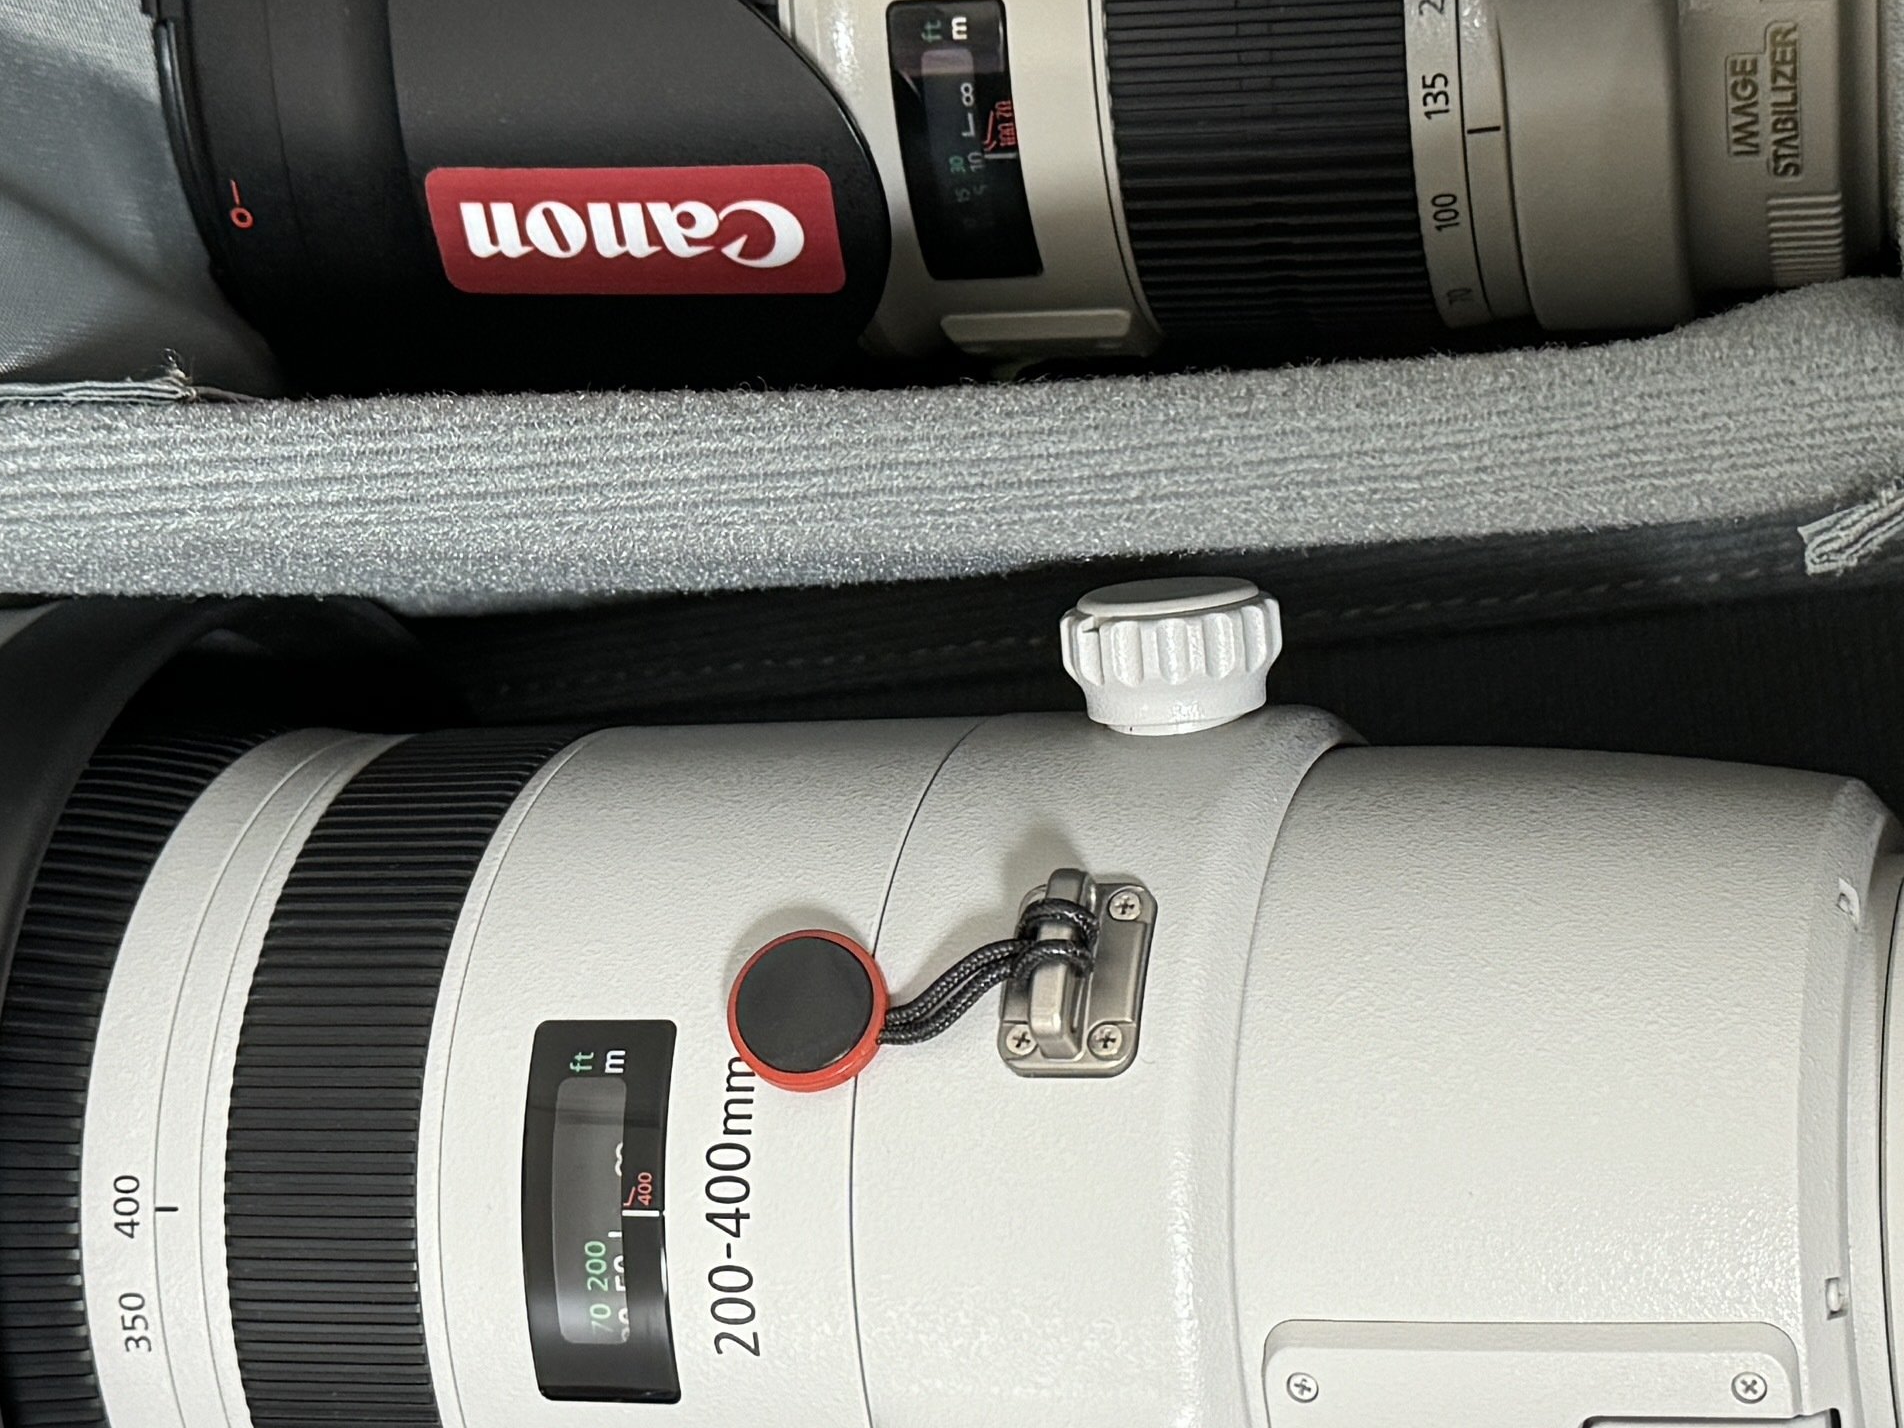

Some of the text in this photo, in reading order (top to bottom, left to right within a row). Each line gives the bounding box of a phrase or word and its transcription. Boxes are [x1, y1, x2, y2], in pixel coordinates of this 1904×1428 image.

[921, 19, 943, 43] ft
[950, 16, 968, 41] m
[1422, 72, 1450, 120] 135
[1730, 56, 1761, 156] IMAGE
[1769, 22, 1800, 177] STABILIZER
[459, 200, 805, 269] Canon
[1430, 192, 1461, 233] 100
[570, 1050, 595, 1073] ft
[604, 1049, 626, 1074] m
[114, 1175, 141, 1239] 400
[637, 1171, 653, 1207] 400
[704, 1056, 761, 1358] 200-400mm
[584, 1240, 610, 1292] 200
[118, 1292, 152, 1353] 350
